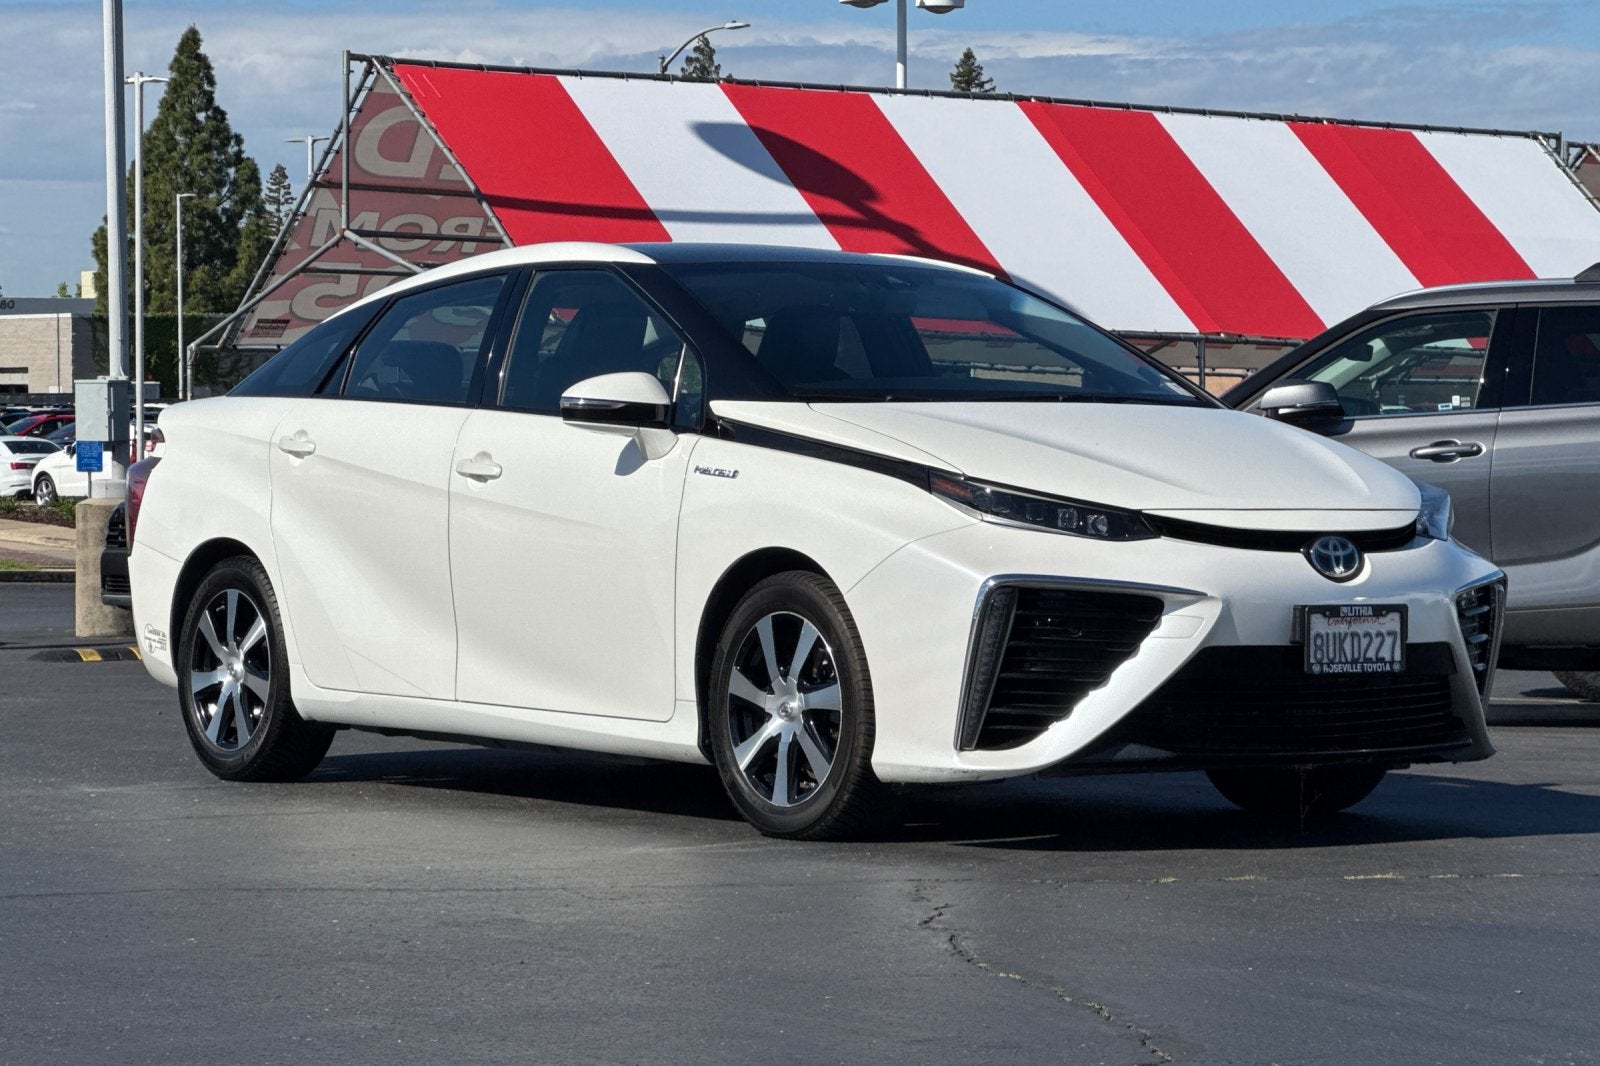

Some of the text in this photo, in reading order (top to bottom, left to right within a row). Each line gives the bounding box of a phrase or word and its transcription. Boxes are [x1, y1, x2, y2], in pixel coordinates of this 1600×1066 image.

[1347, 606, 1373, 616] LITHIA
[1313, 630, 1398, 664] 8UKD227
[1323, 662, 1391, 673] ROSEVILLE TOYOTA
